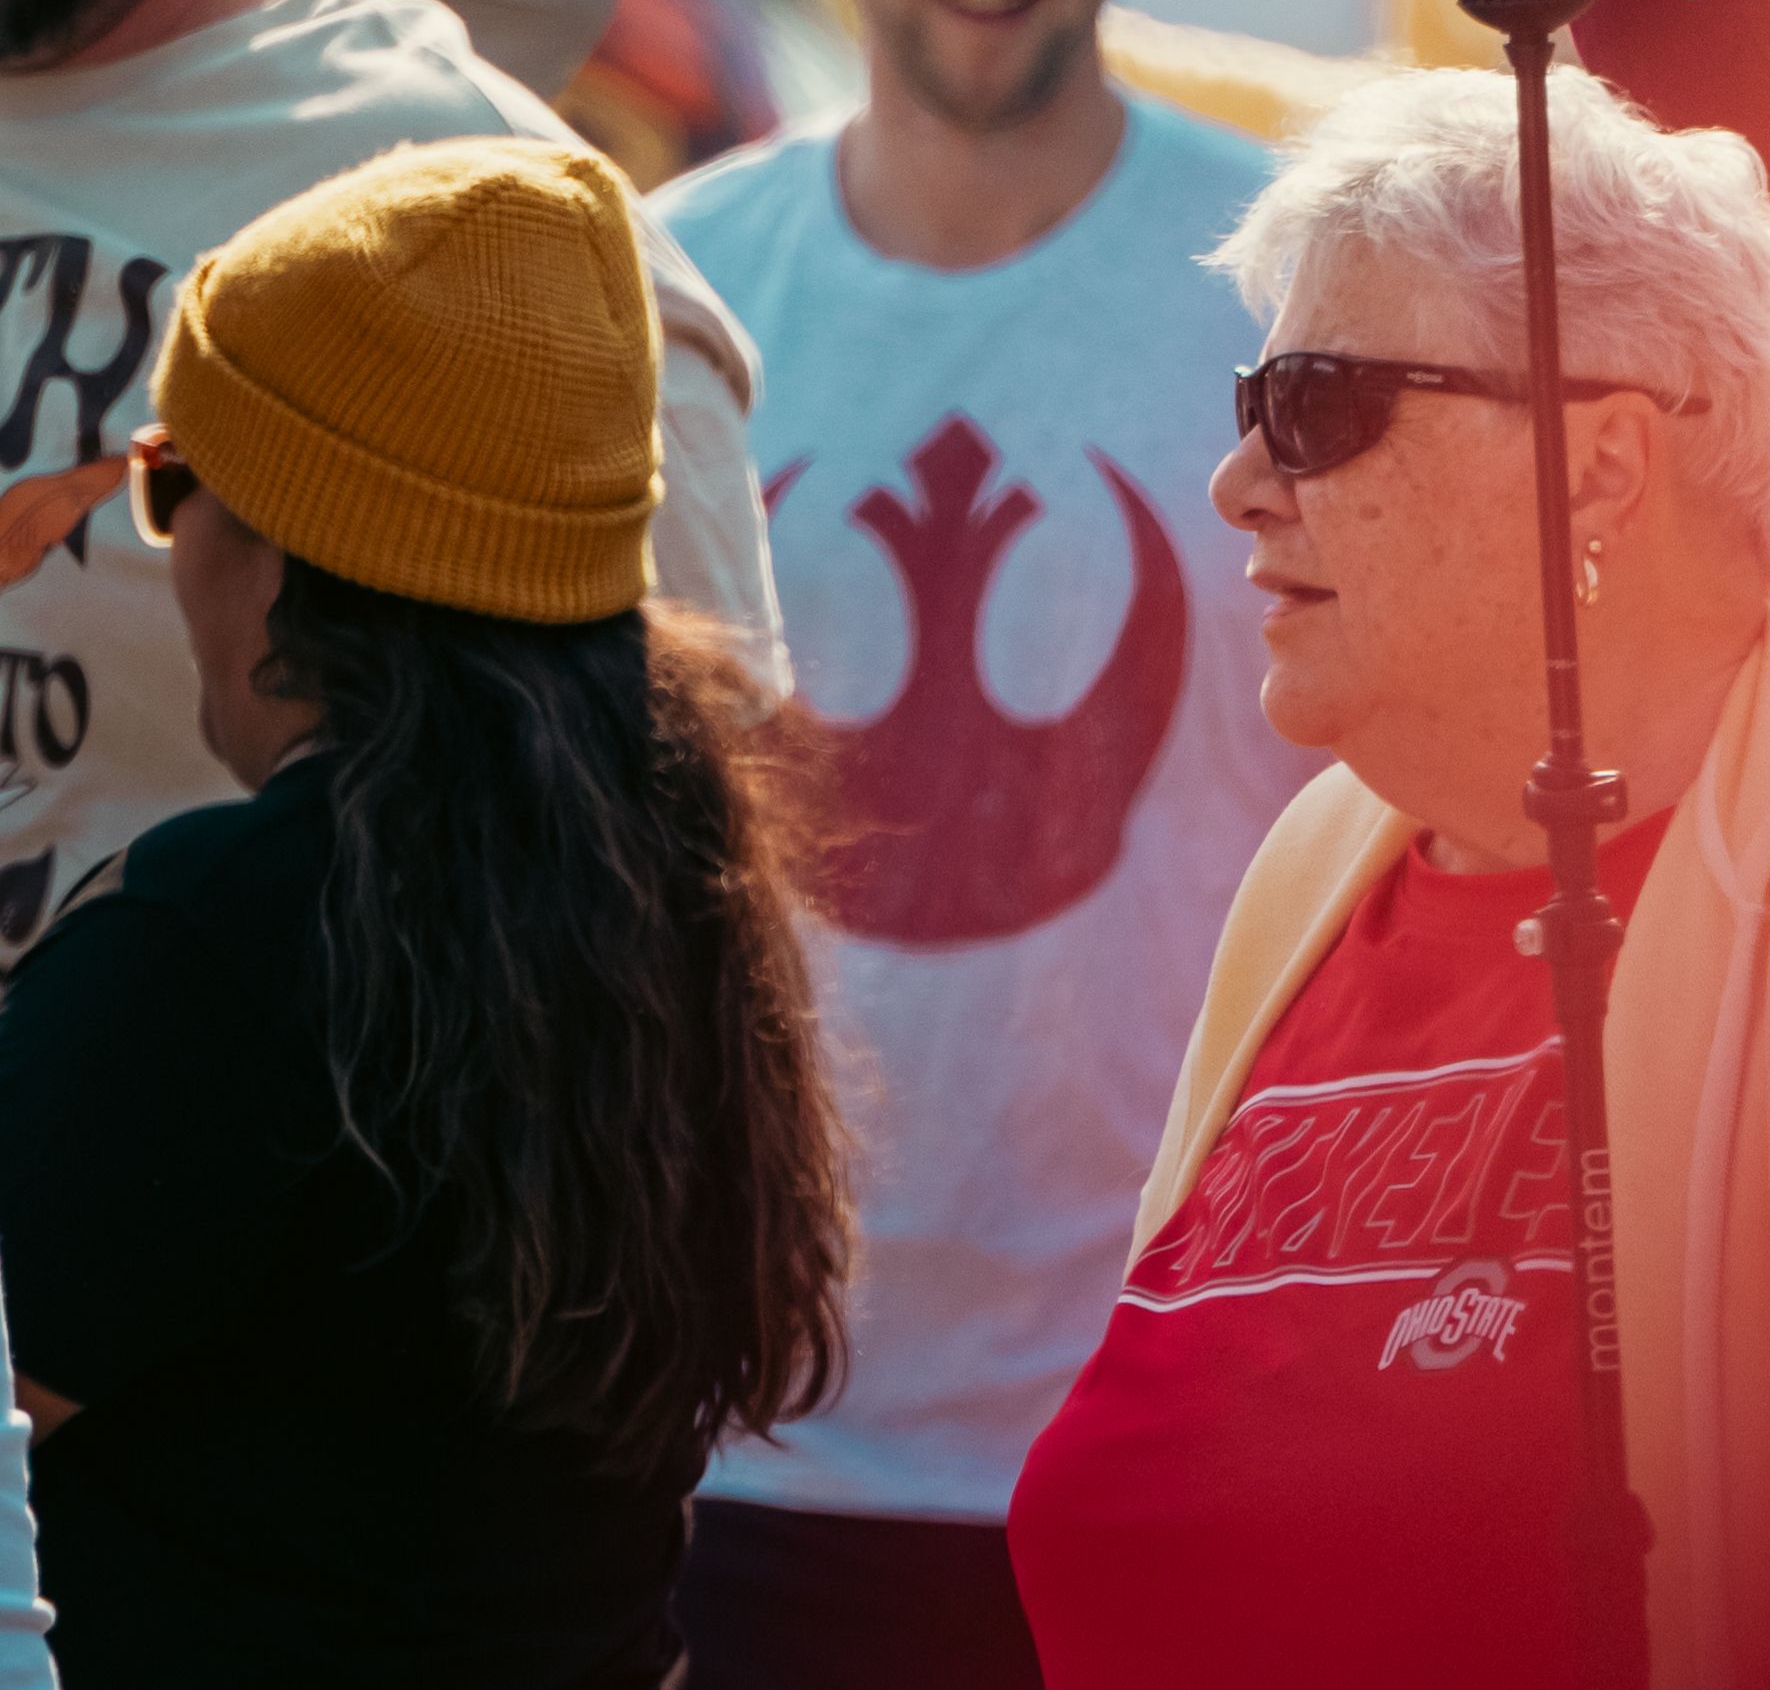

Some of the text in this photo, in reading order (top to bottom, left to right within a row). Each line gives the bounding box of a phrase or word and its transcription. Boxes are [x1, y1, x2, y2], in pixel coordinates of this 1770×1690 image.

[1376, 1287, 1528, 1372] OHIO STATE
[1580, 1147, 1621, 1374] montem
